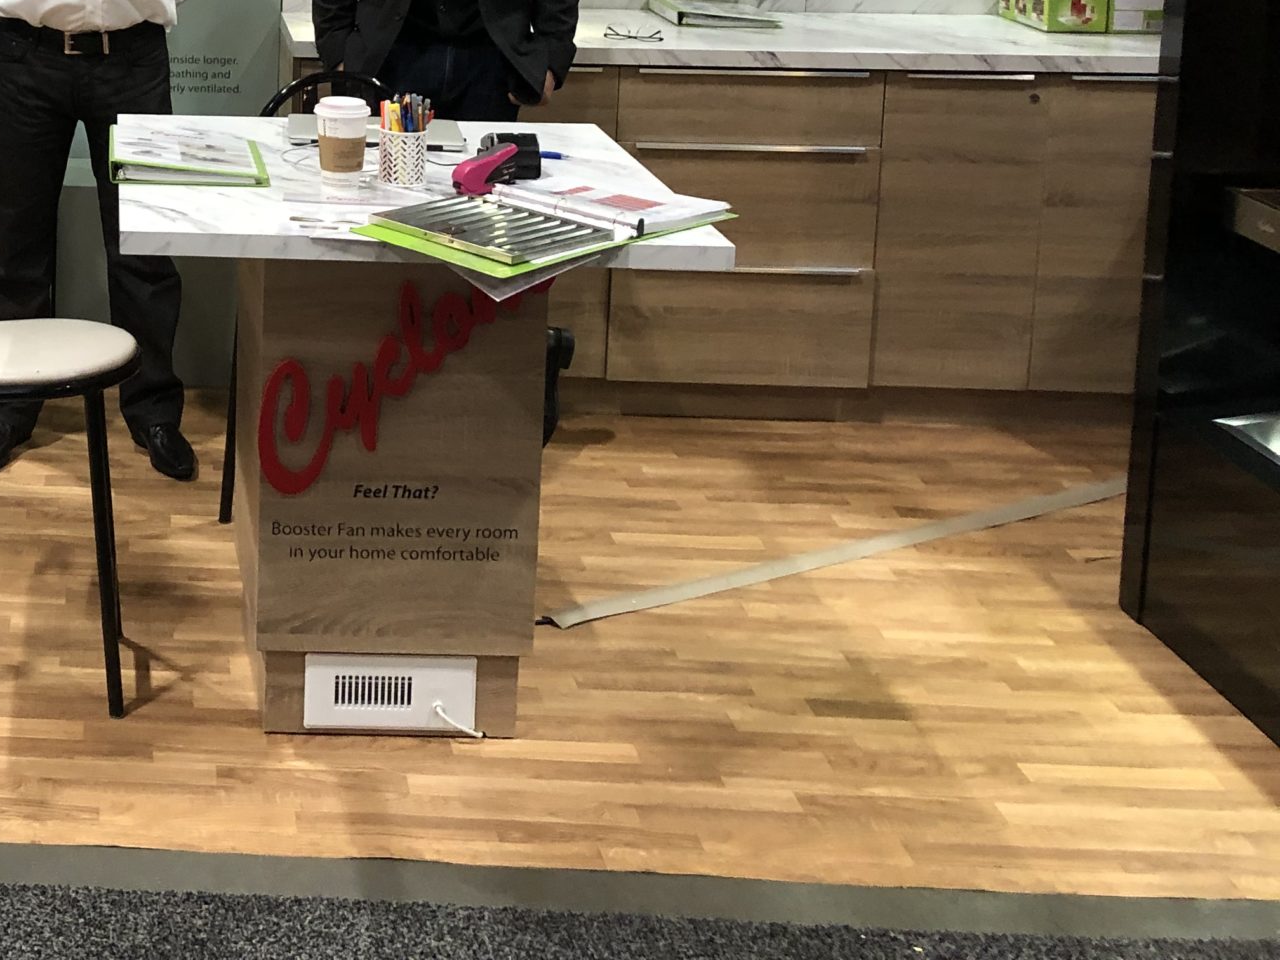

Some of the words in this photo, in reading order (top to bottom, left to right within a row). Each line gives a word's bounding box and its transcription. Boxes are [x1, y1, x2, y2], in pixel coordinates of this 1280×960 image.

[170, 55, 200, 64] inside
[203, 56, 239, 67] longer.
[211, 70, 231, 79] and
[188, 84, 242, 94] ventilated.
[353, 484, 388, 499] Feel
[392, 484, 440, 499] That?
[271, 521, 332, 536] Booster
[337, 522, 365, 537] Fan
[370, 523, 422, 537] makes
[426, 527, 471, 541] every
[475, 527, 519, 539] room
[289, 547, 304, 559] in
[308, 548, 344, 562] your
[349, 546, 396, 560] home
[400, 546, 500, 561] comfortable
